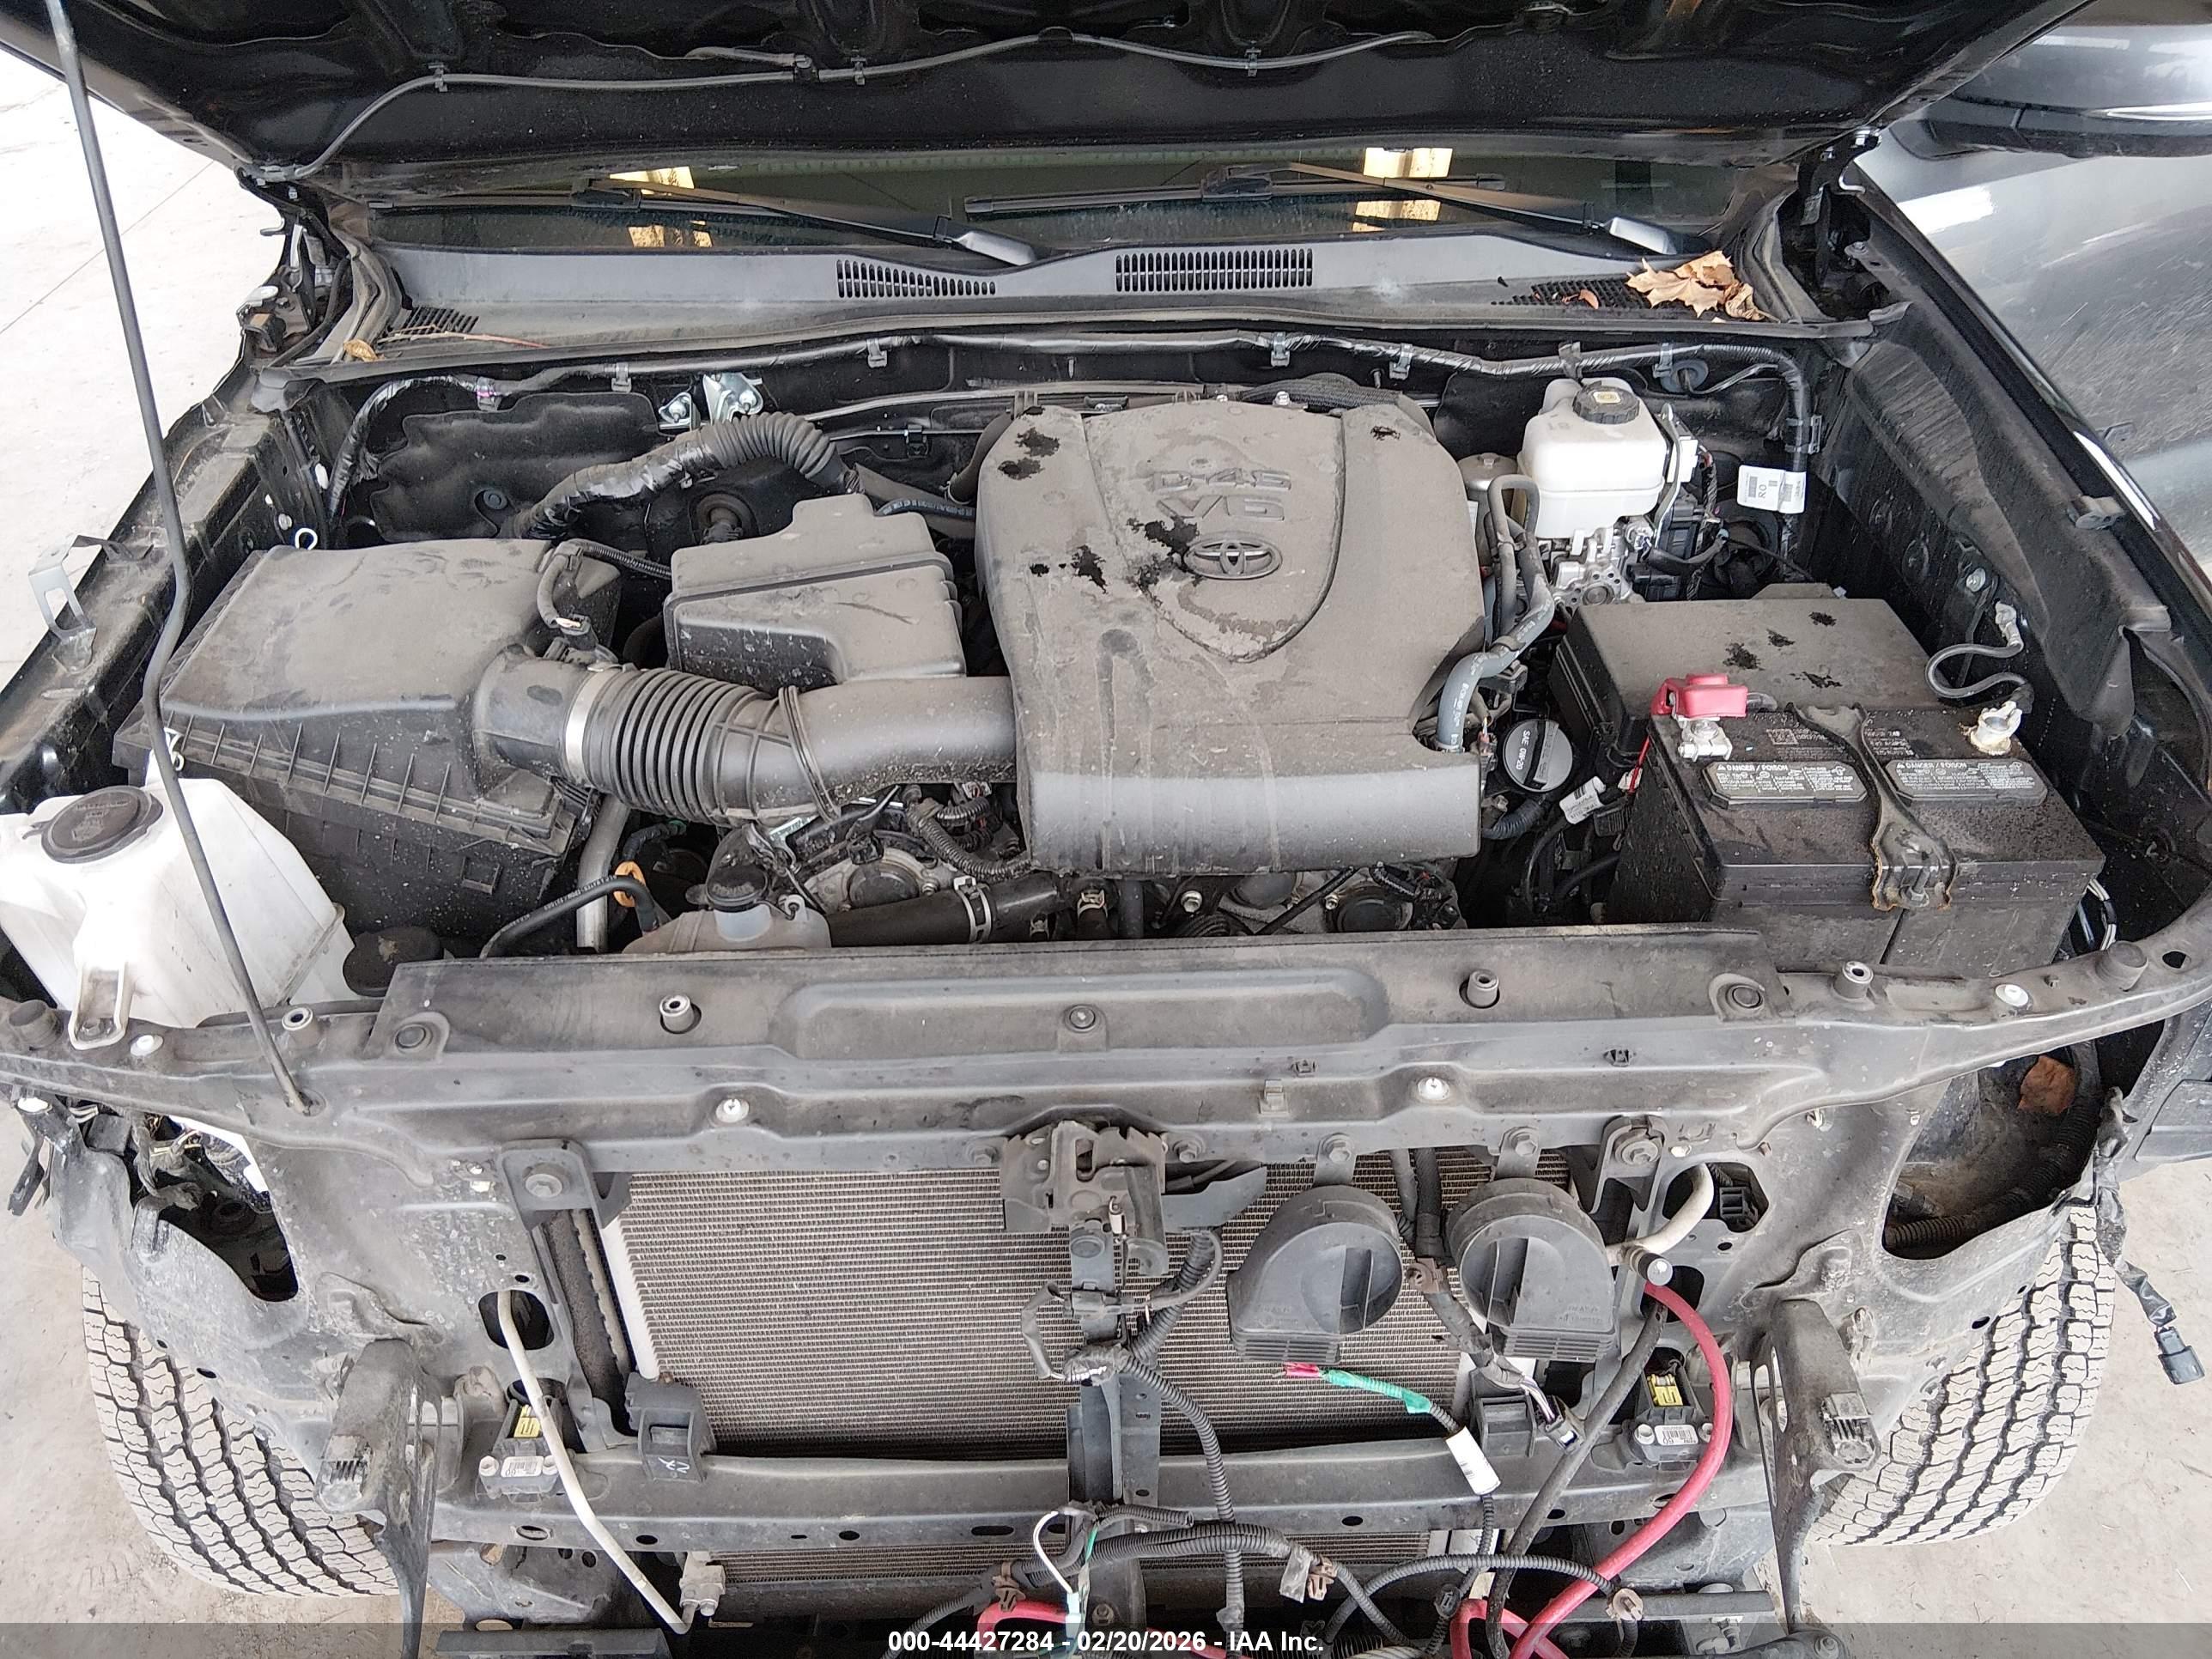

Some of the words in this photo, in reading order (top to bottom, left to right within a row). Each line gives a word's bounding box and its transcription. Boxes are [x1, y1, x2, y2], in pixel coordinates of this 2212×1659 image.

[1157, 495, 1285, 522] V6
[1521, 729, 1531, 746] SAE
[1516, 747, 1527, 770] 0W-20
